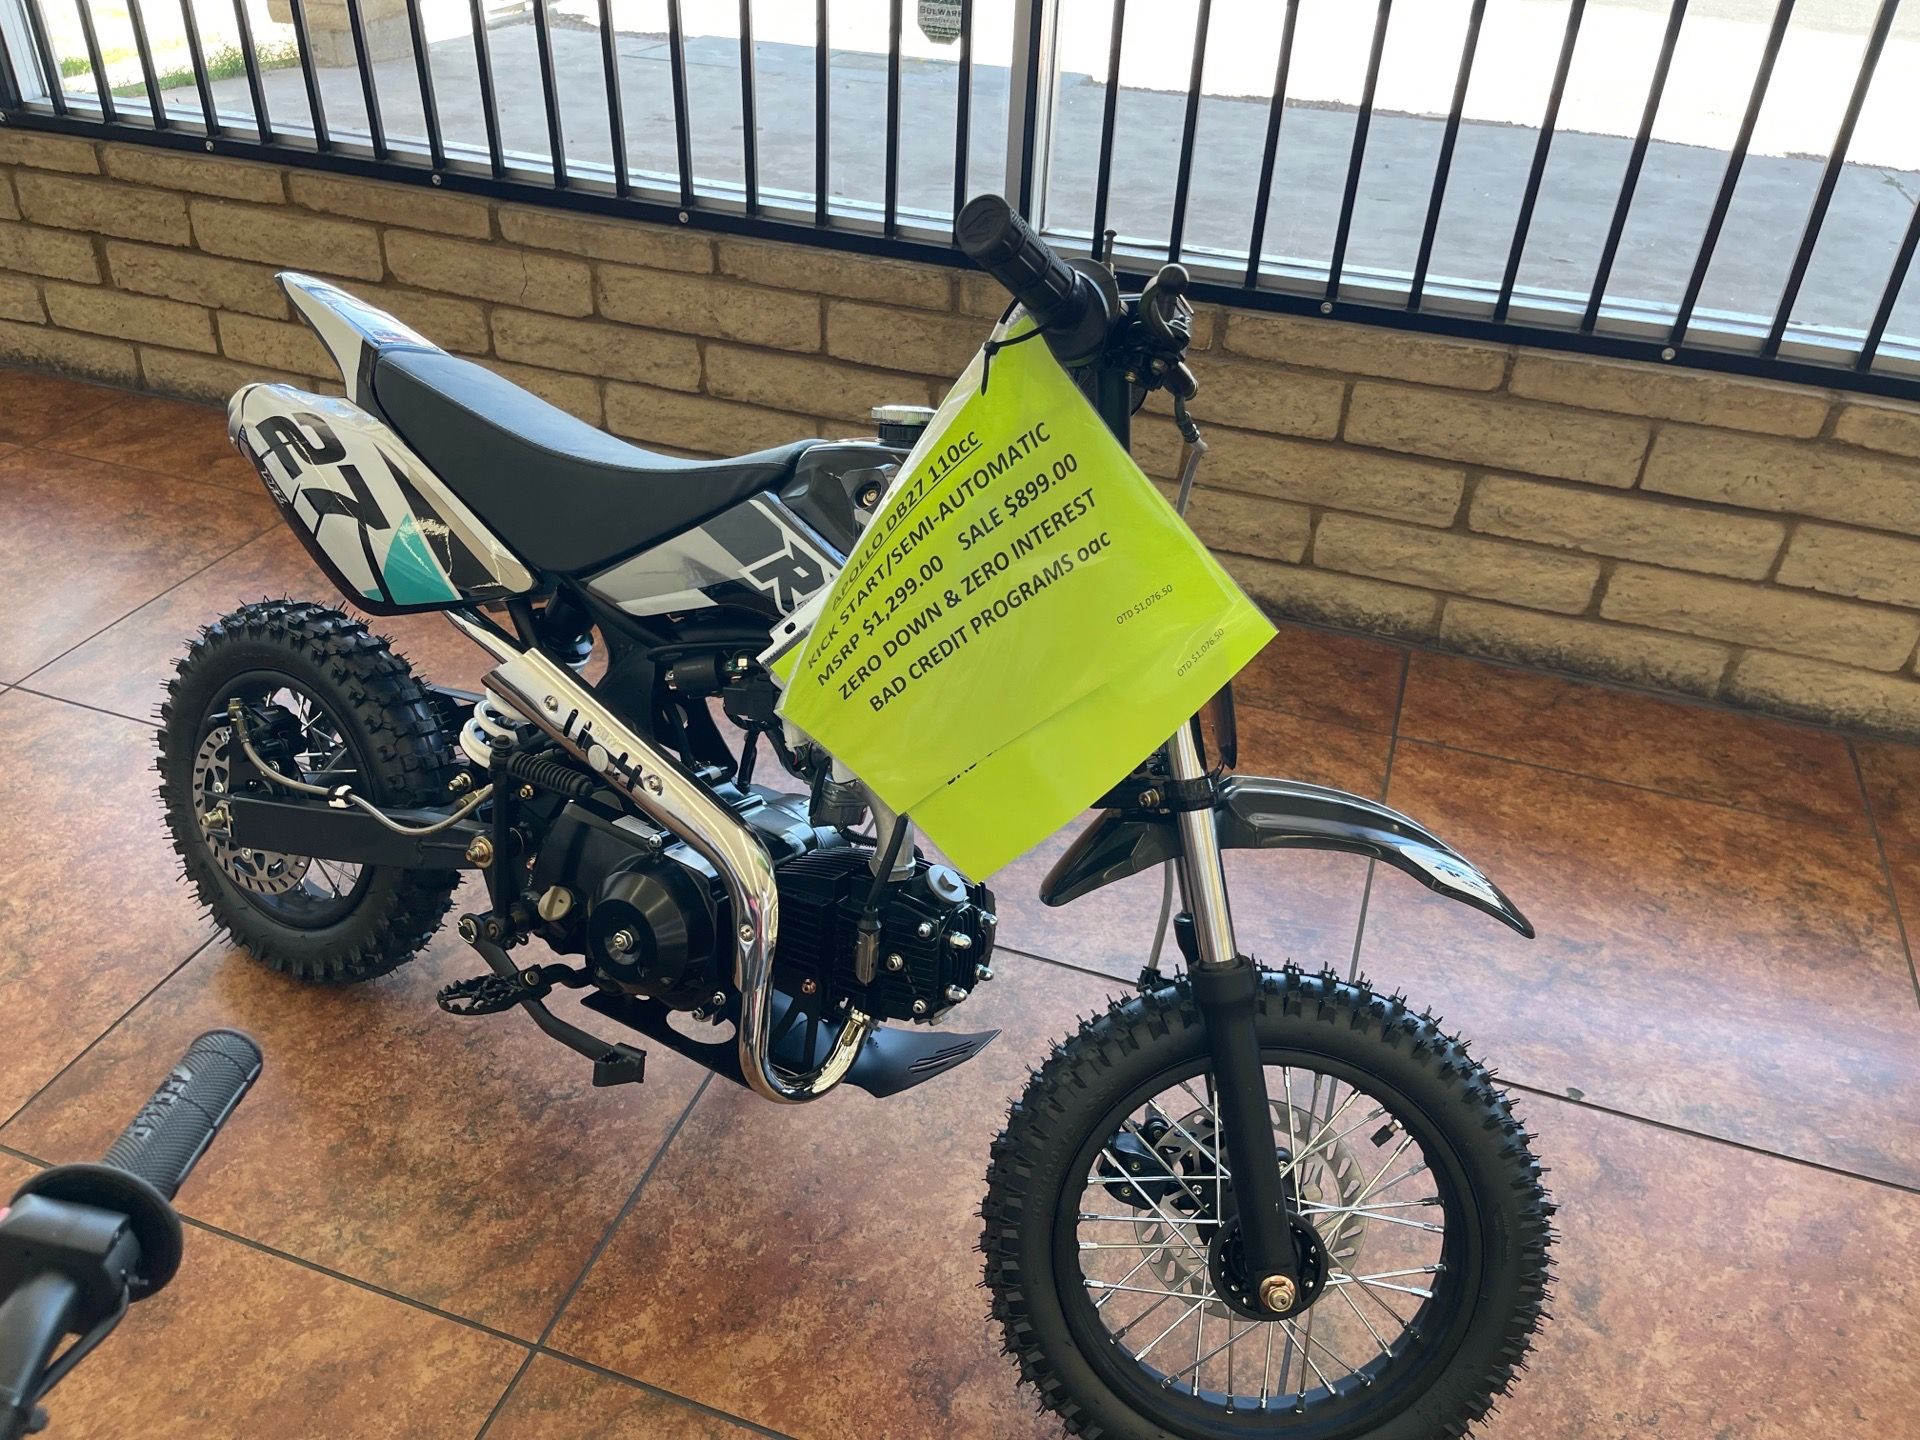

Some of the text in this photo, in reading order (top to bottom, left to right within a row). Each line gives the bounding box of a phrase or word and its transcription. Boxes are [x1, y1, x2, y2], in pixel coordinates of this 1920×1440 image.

[255, 412, 391, 530] 27
[807, 624, 839, 669] KICK
[839, 422, 1051, 625] START/SEMI-AUTOMATIC
[832, 431, 979, 611] APOLLO DB27 110cc
[817, 453, 1077, 687] MSRP $1,299.00 SALE $899.00
[838, 487, 1096, 700] ZERO DOWN & ZERO INTEREST
[869, 532, 1111, 712] BAD CREDIT PROGRAMS oac
[1116, 584, 1173, 625] OTD $1,076.50
[1177, 628, 1225, 677] OTD $1,076.50
